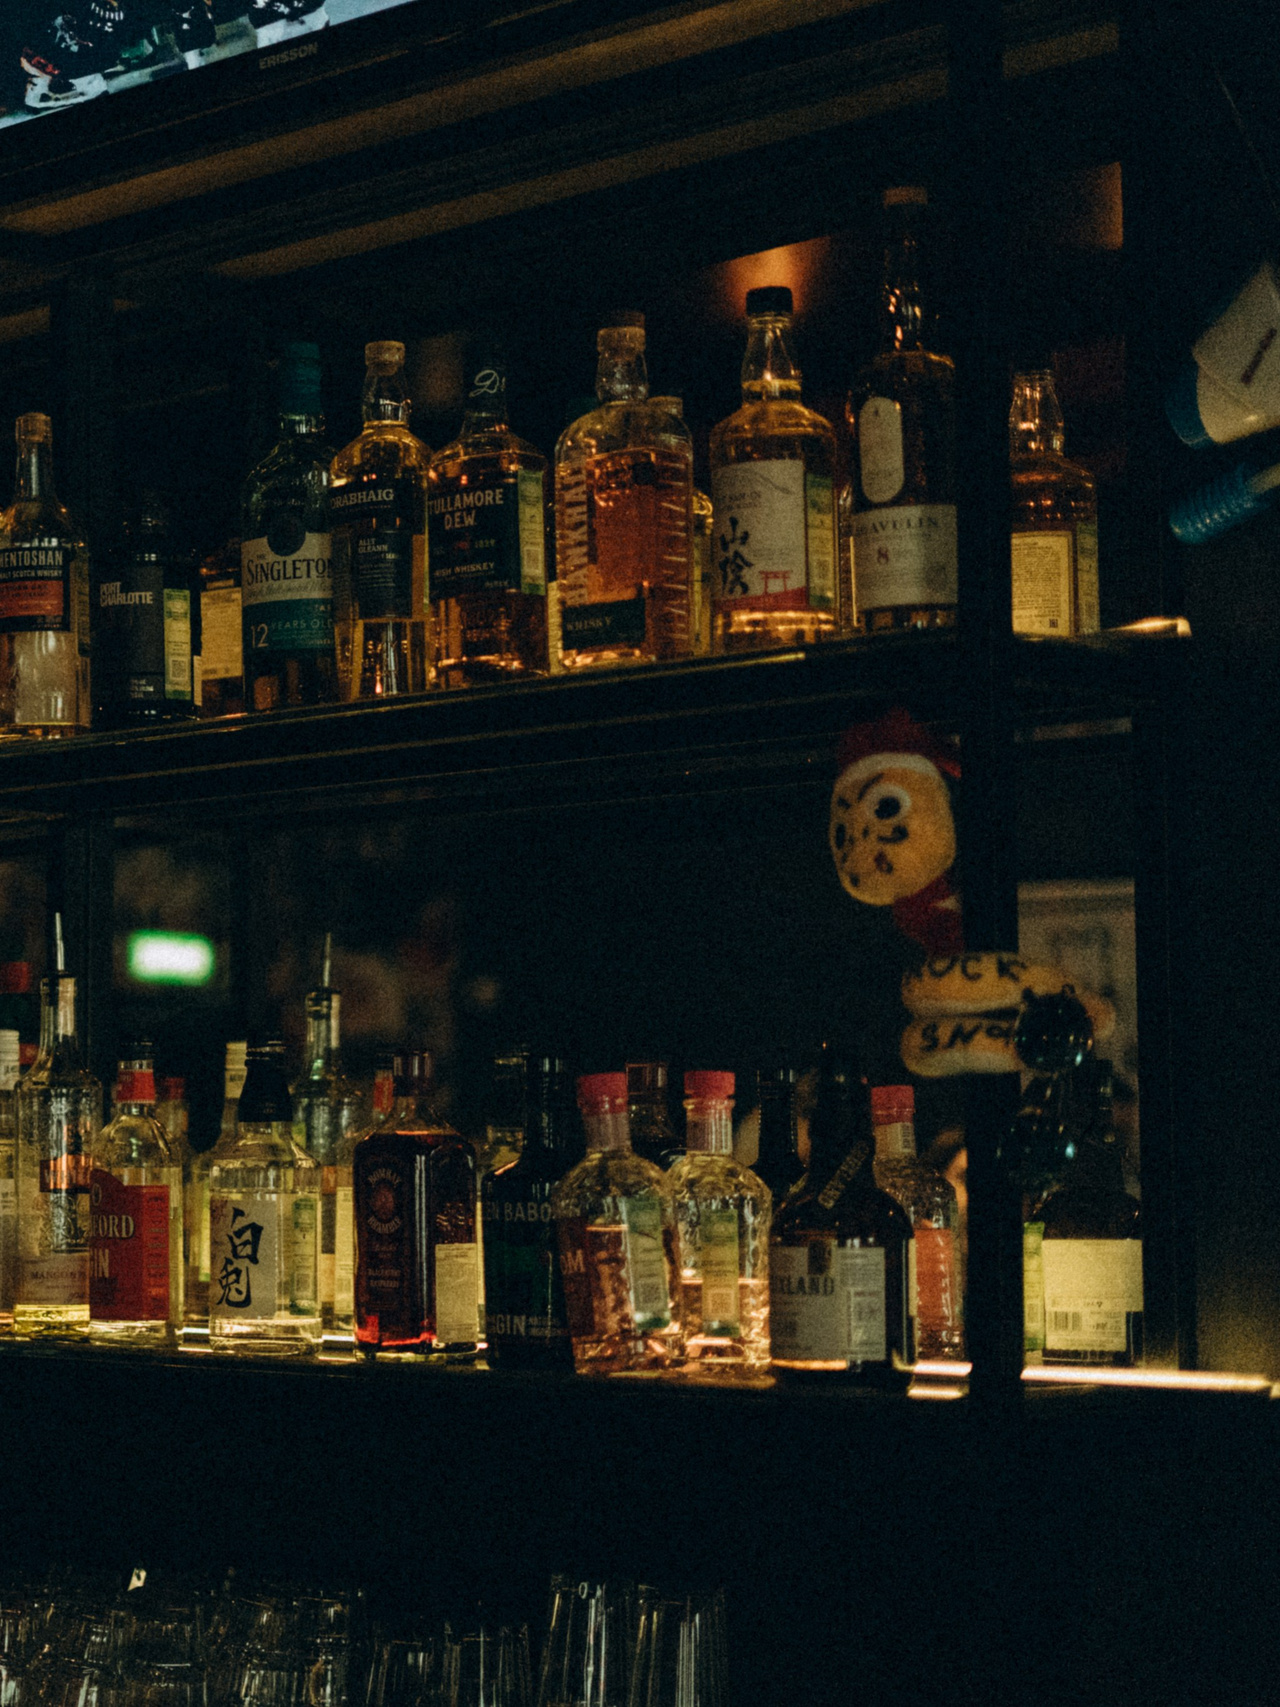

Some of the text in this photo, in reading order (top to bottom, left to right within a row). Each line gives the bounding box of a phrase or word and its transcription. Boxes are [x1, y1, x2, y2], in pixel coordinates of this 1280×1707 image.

[259, 42, 319, 70] ERISSON
[428, 488, 505, 515] TULLAMORE
[250, 622, 270, 649] 12
[496, 1313, 527, 1337] GIN
